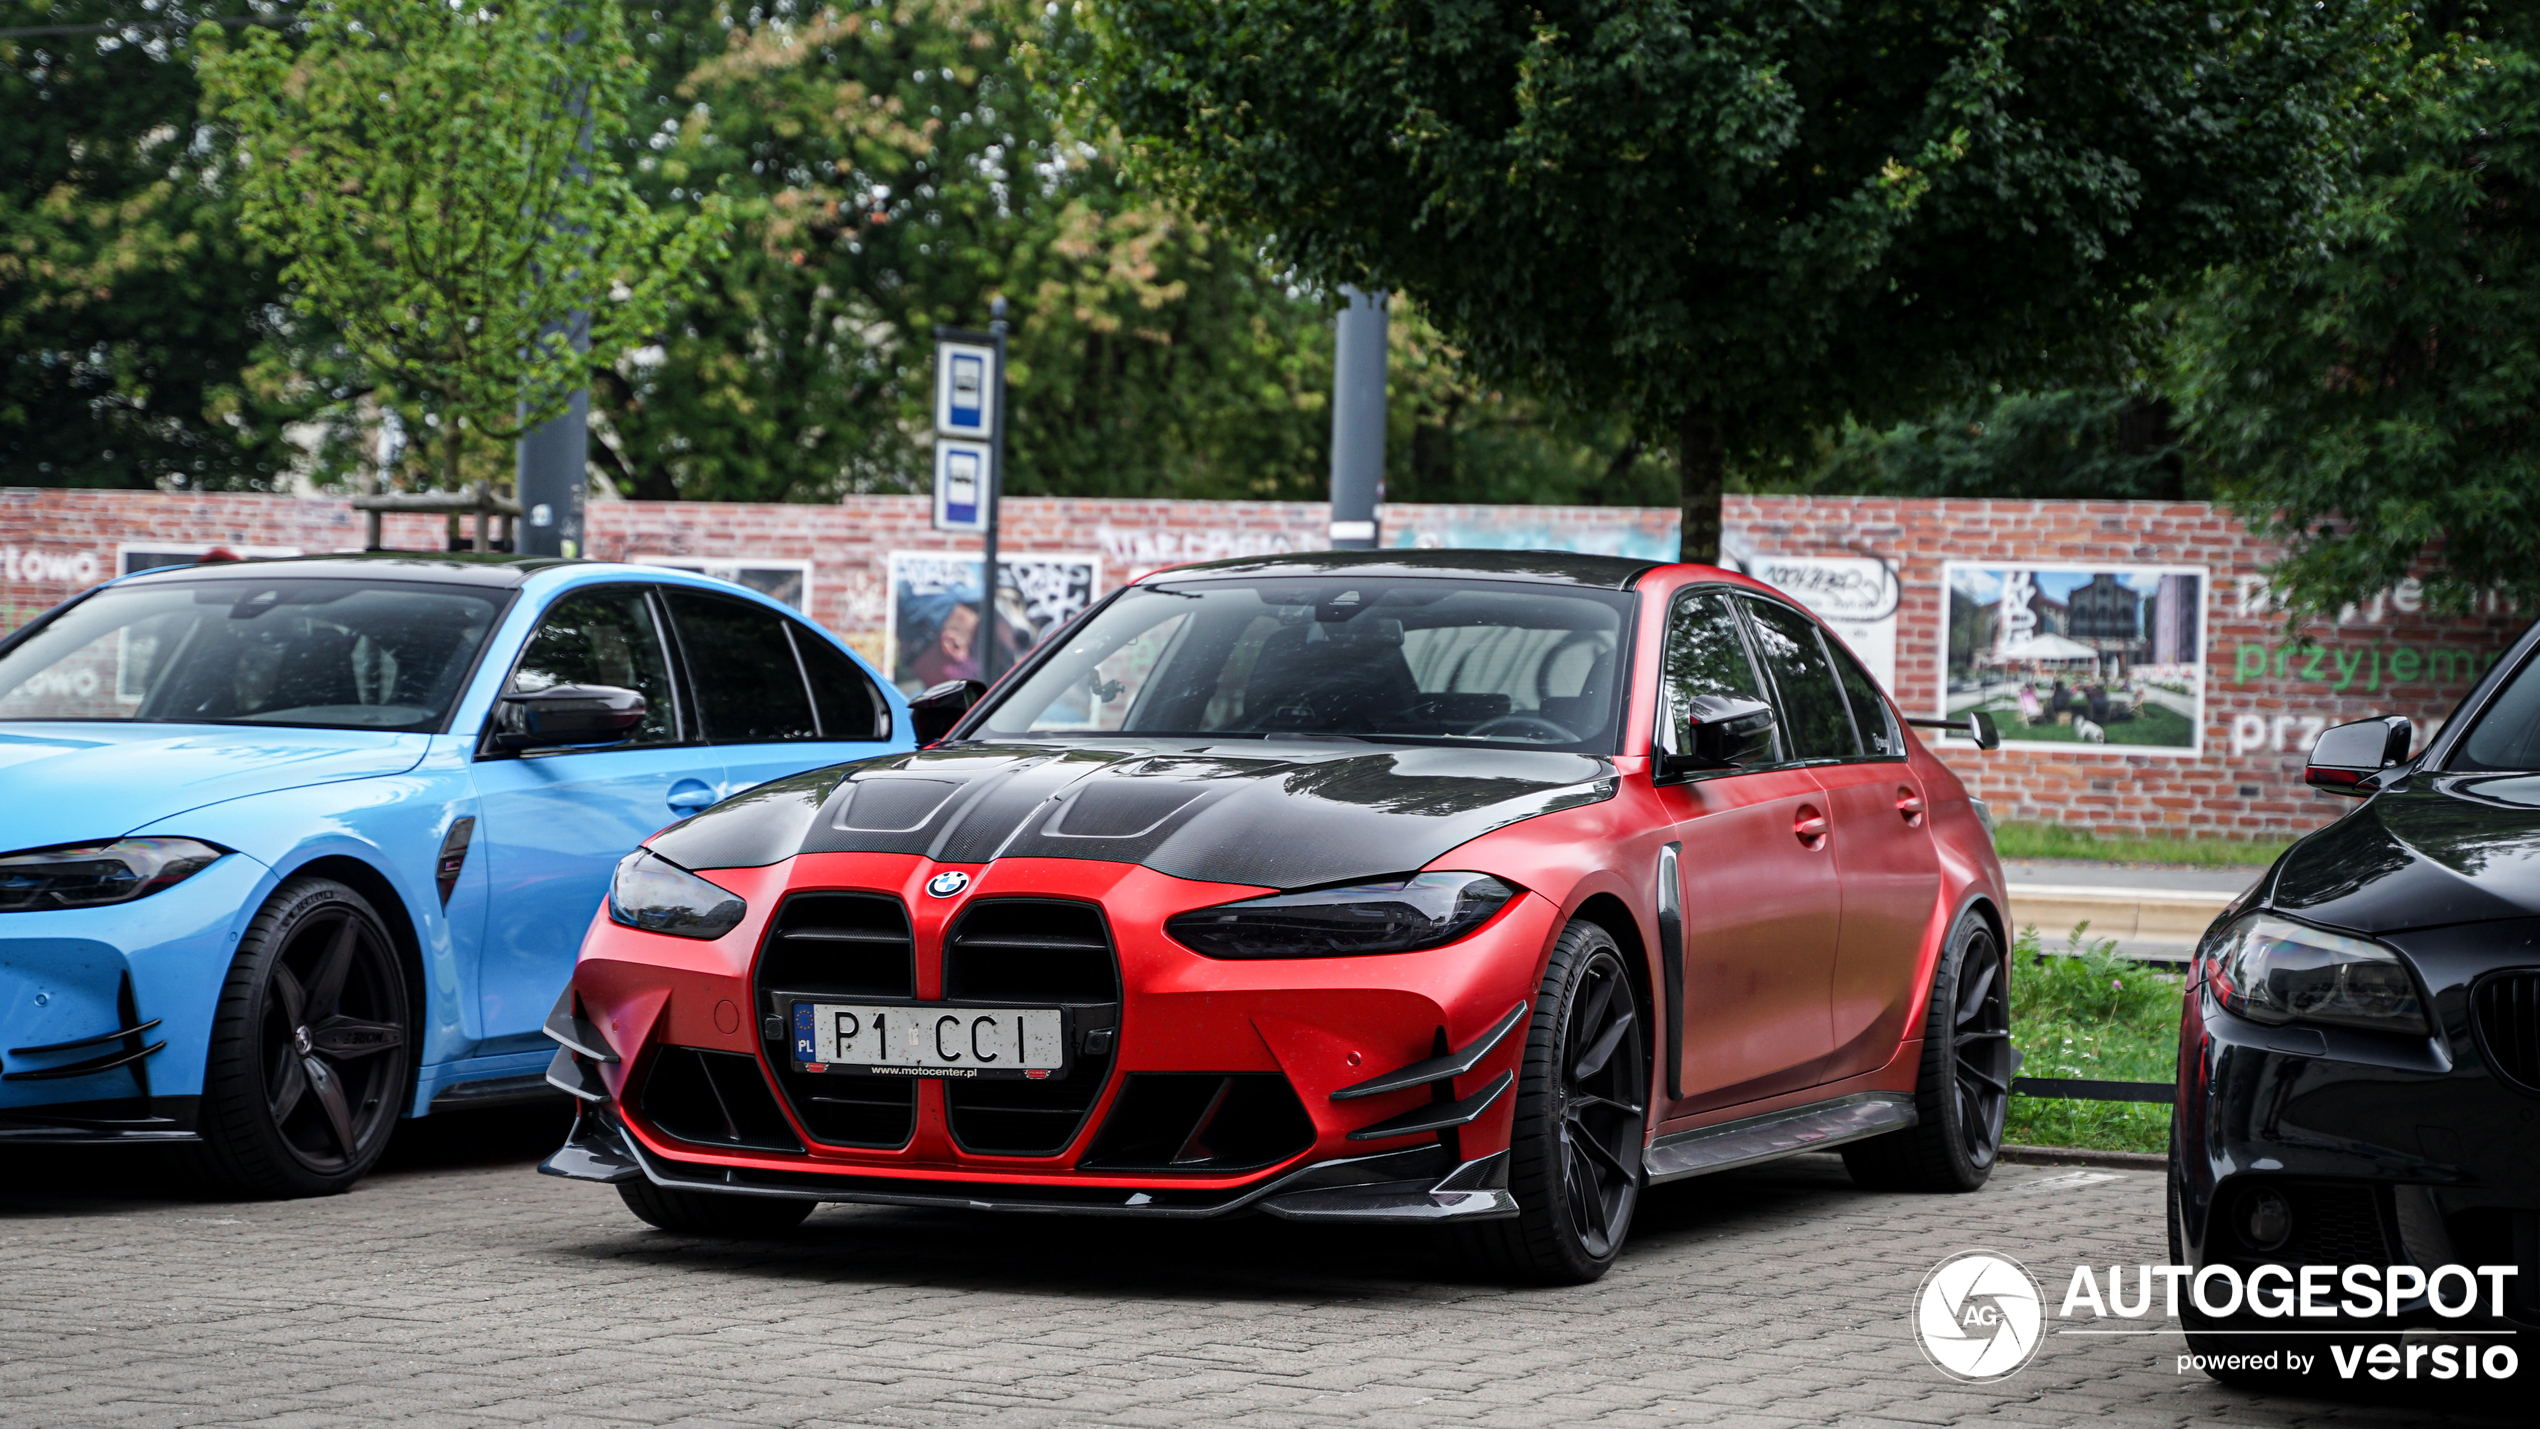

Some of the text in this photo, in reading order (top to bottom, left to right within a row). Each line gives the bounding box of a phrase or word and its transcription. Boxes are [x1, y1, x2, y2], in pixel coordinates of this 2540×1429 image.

[0, 545, 98, 582] towo
[798, 1039, 814, 1053] PL
[834, 1011, 1025, 1064] P1 CCI
[871, 1066, 978, 1078] www.motocenter.pl
